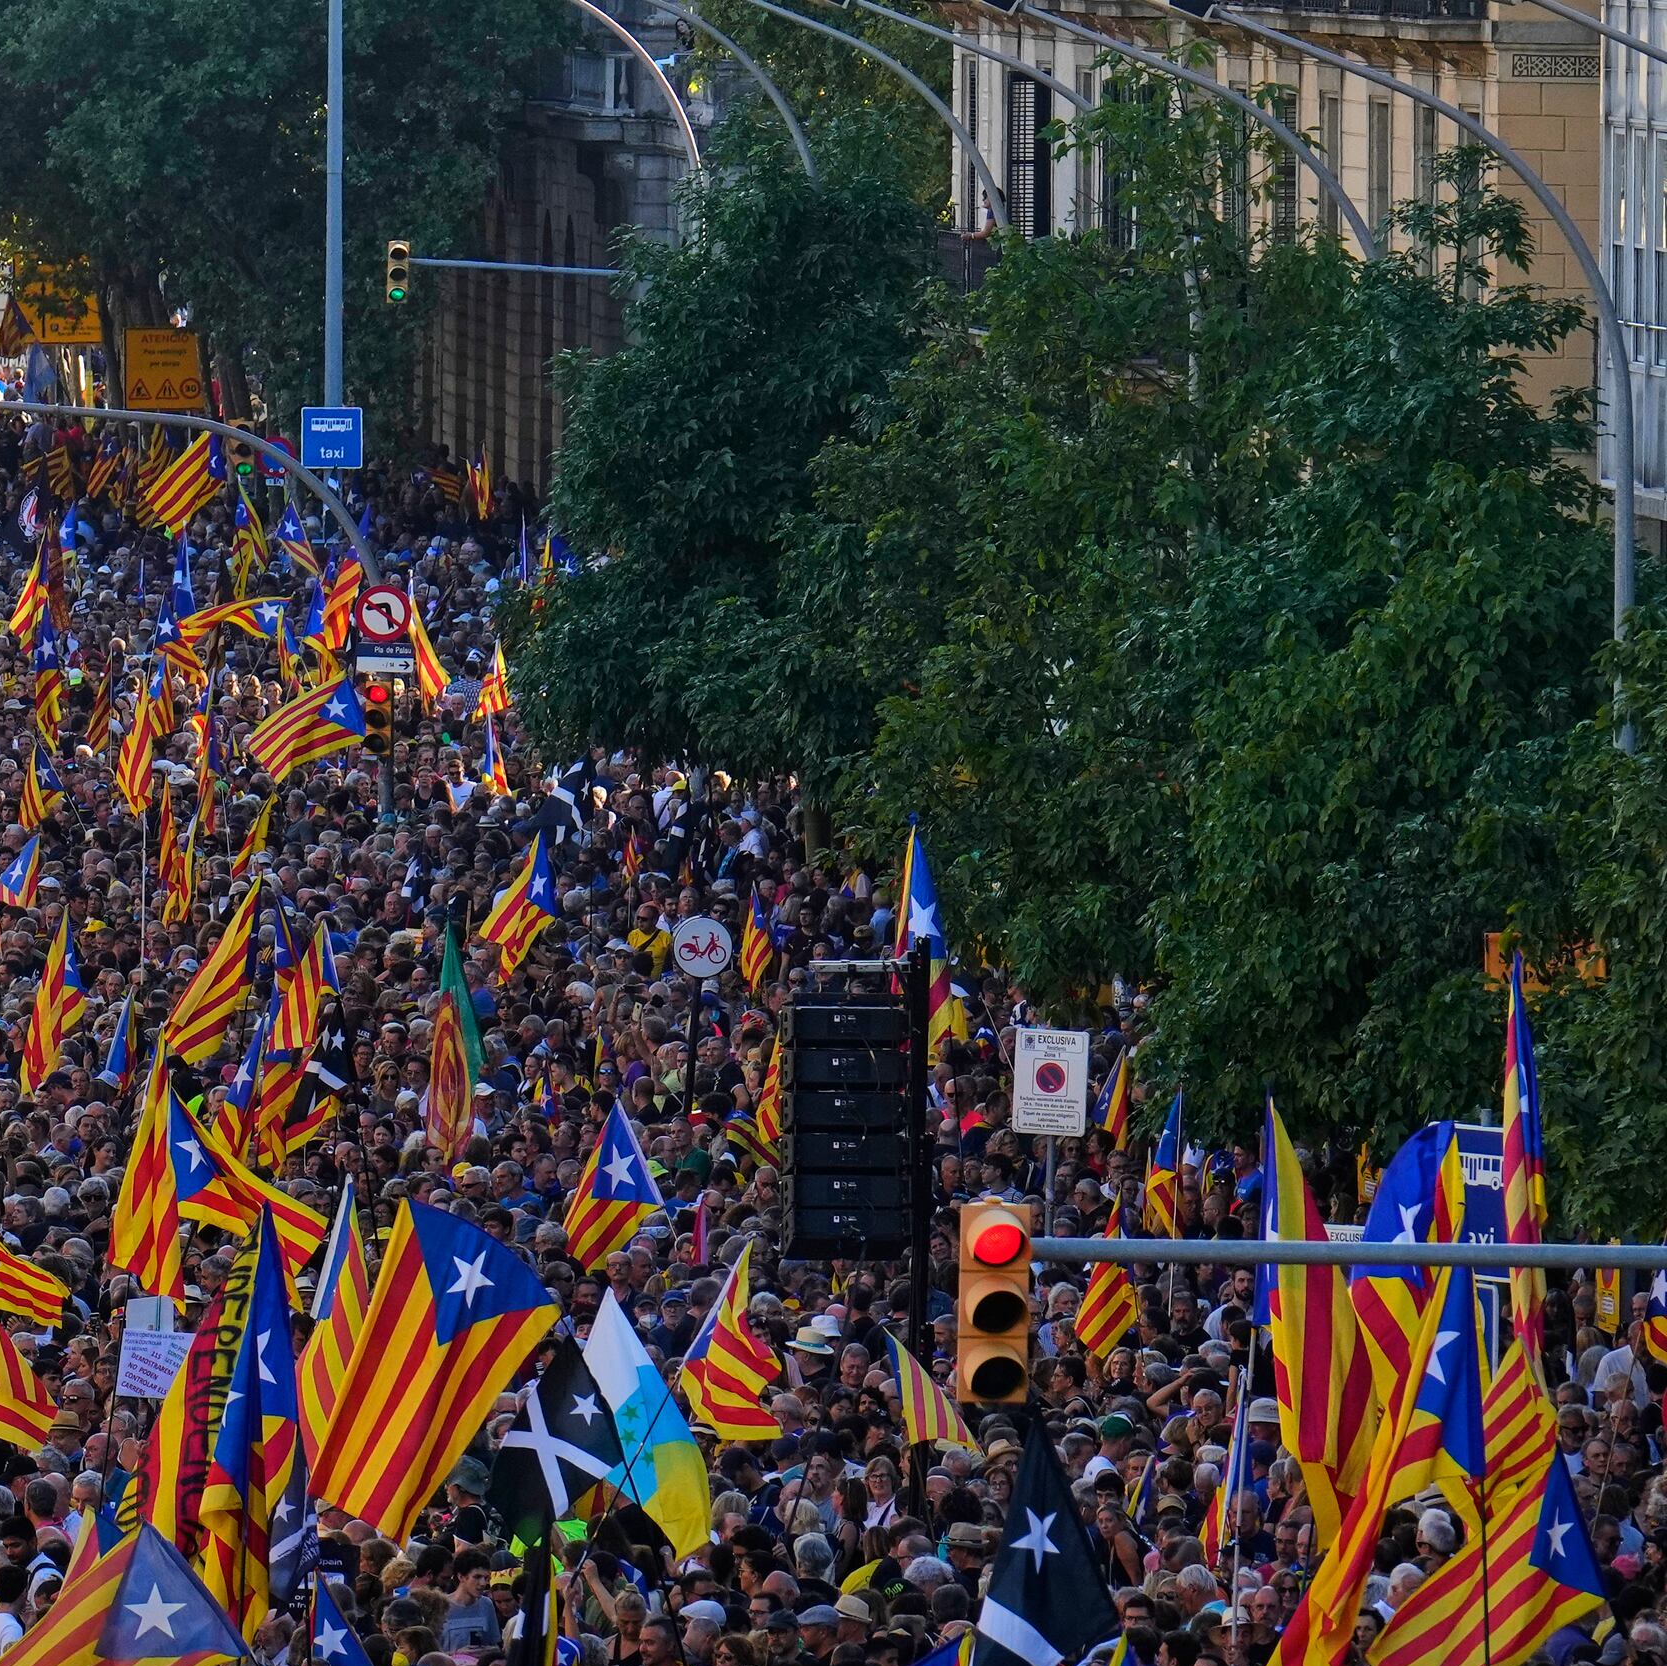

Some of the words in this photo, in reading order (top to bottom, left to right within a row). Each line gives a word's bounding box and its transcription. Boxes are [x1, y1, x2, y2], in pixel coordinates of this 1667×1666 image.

[141, 333, 189, 344] ATENCIÓ
[320, 446, 345, 459] taxi
[374, 645, 384, 654] Pla
[386, 645, 394, 654] de
[395, 645, 412, 655] Palau
[1038, 1035, 1076, 1046] EXCLUSIVA
[128, 1362, 138, 1370] NO
[138, 1367, 159, 1380] PODEN
[130, 1352, 174, 1377] DEMOSTRAREM
[121, 1380, 147, 1396] CARRERS
[124, 1371, 158, 1391] CONTROLAR
